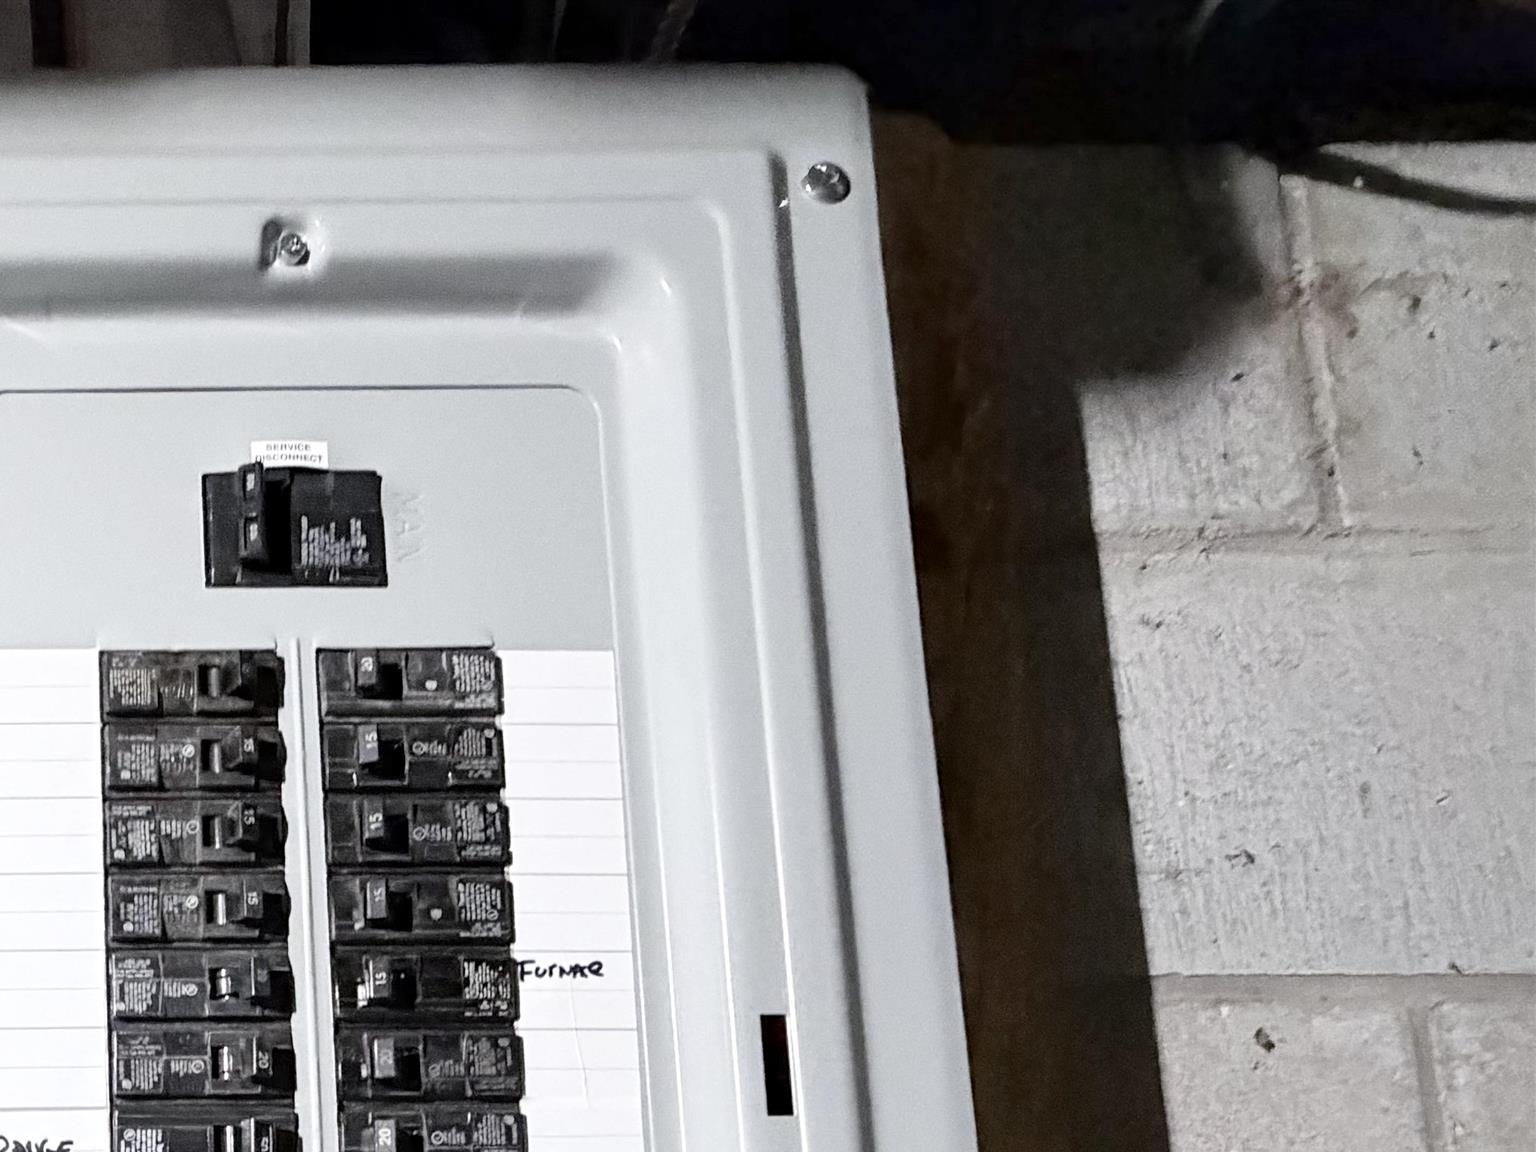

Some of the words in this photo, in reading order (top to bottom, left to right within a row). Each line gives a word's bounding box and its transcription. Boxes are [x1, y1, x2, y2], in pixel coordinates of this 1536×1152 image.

[266, 443, 312, 452] SERVICE
[368, 812, 382, 830] 15
[257, 1050, 270, 1069] 20
[378, 1128, 393, 1146] 20
